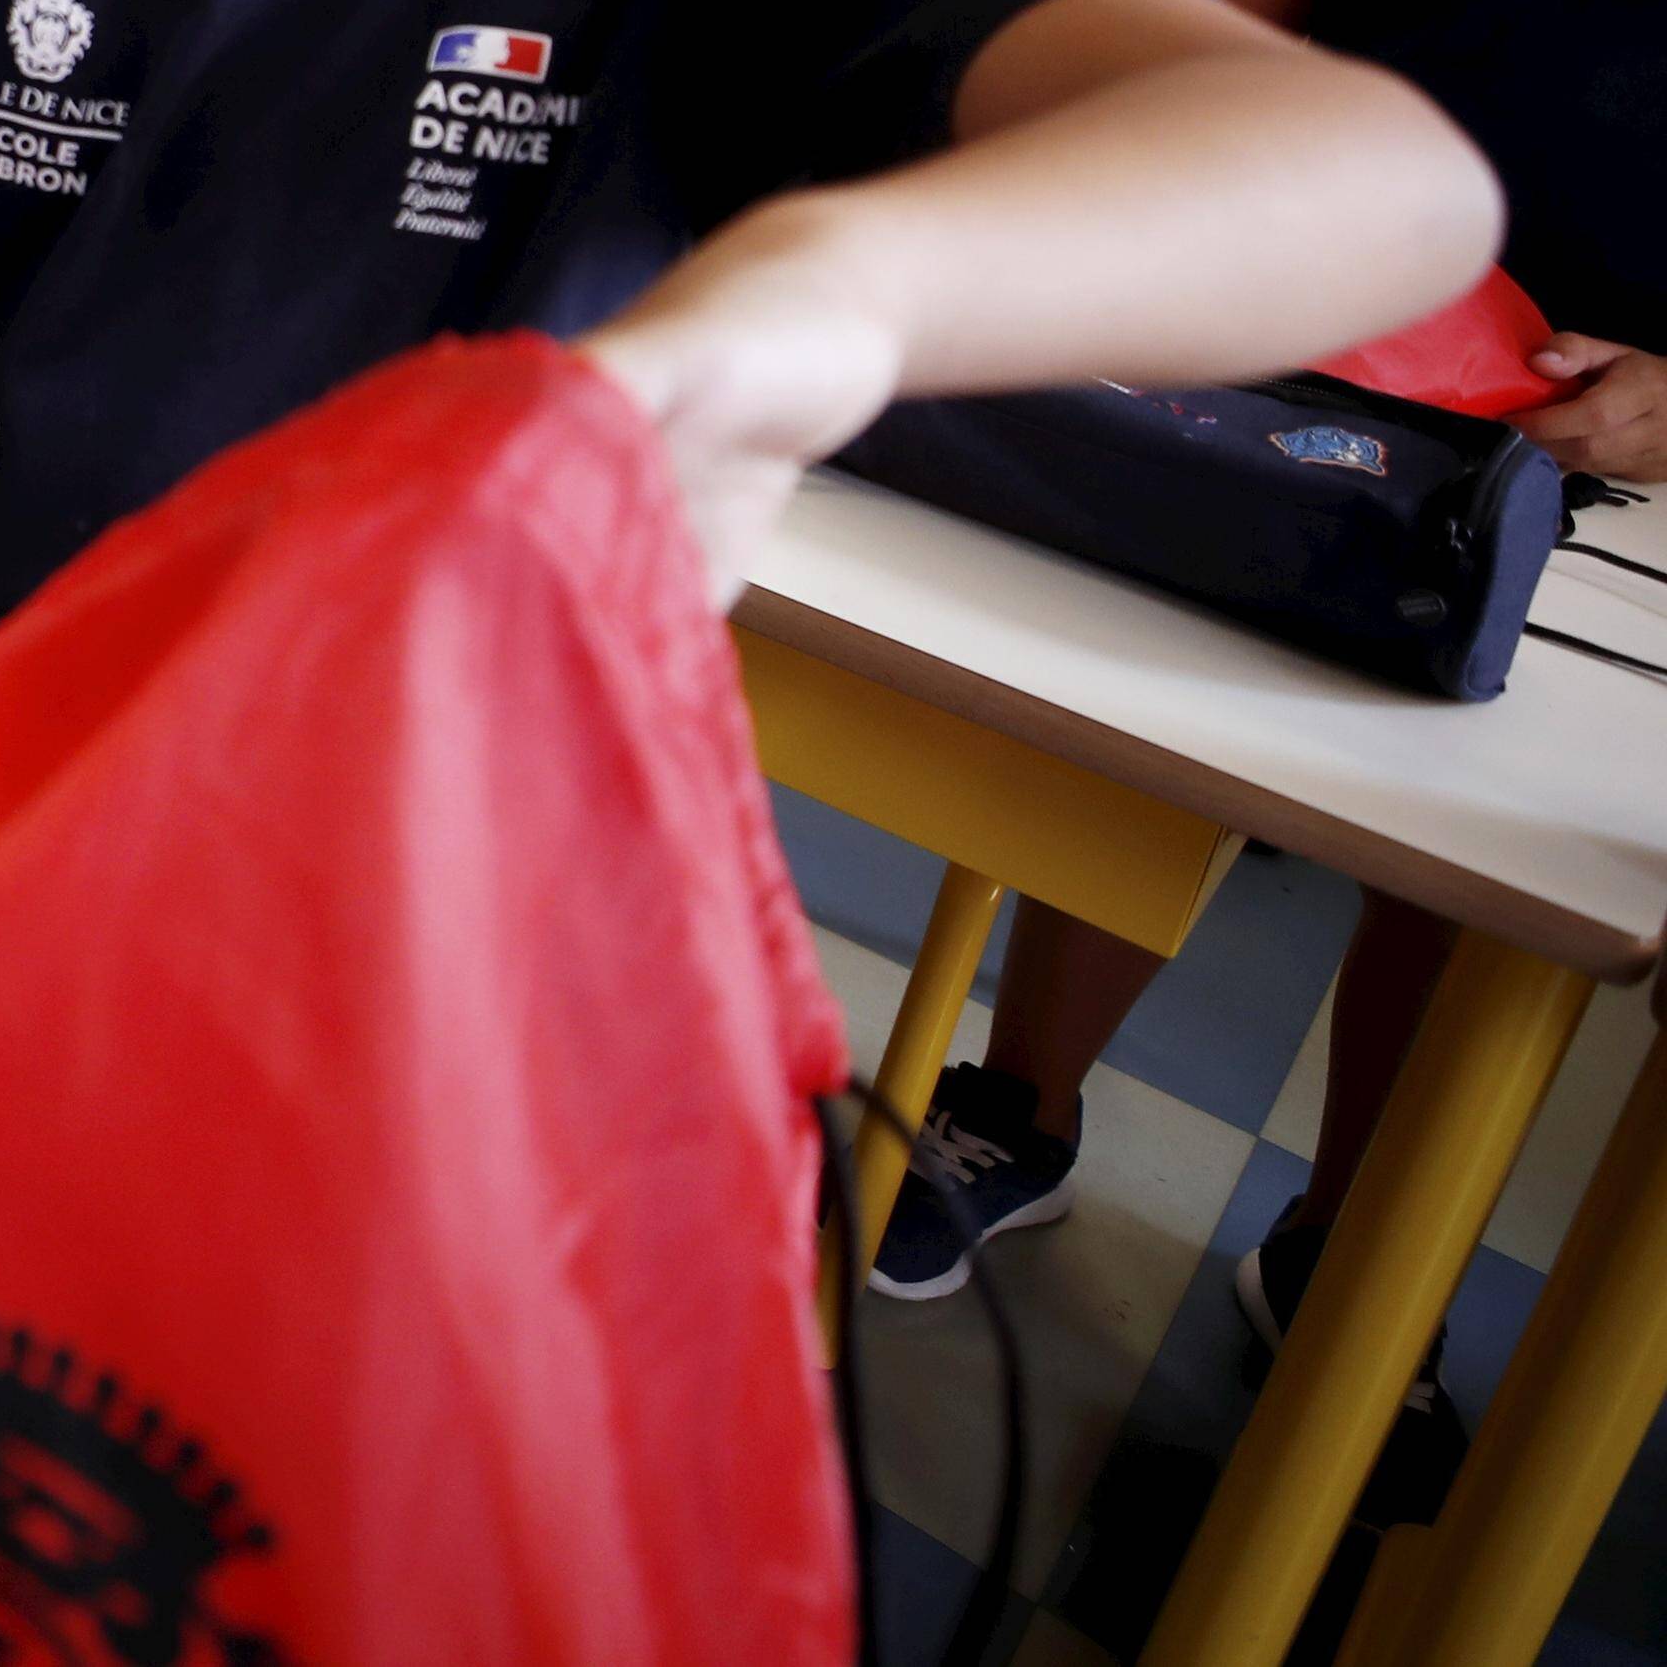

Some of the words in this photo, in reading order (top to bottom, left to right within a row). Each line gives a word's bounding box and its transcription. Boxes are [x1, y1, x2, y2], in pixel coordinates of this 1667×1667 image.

[20, 86, 59, 117] DE
[61, 96, 131, 126] NICE
[409, 114, 468, 154] DE
[472, 125, 551, 165] NICE
